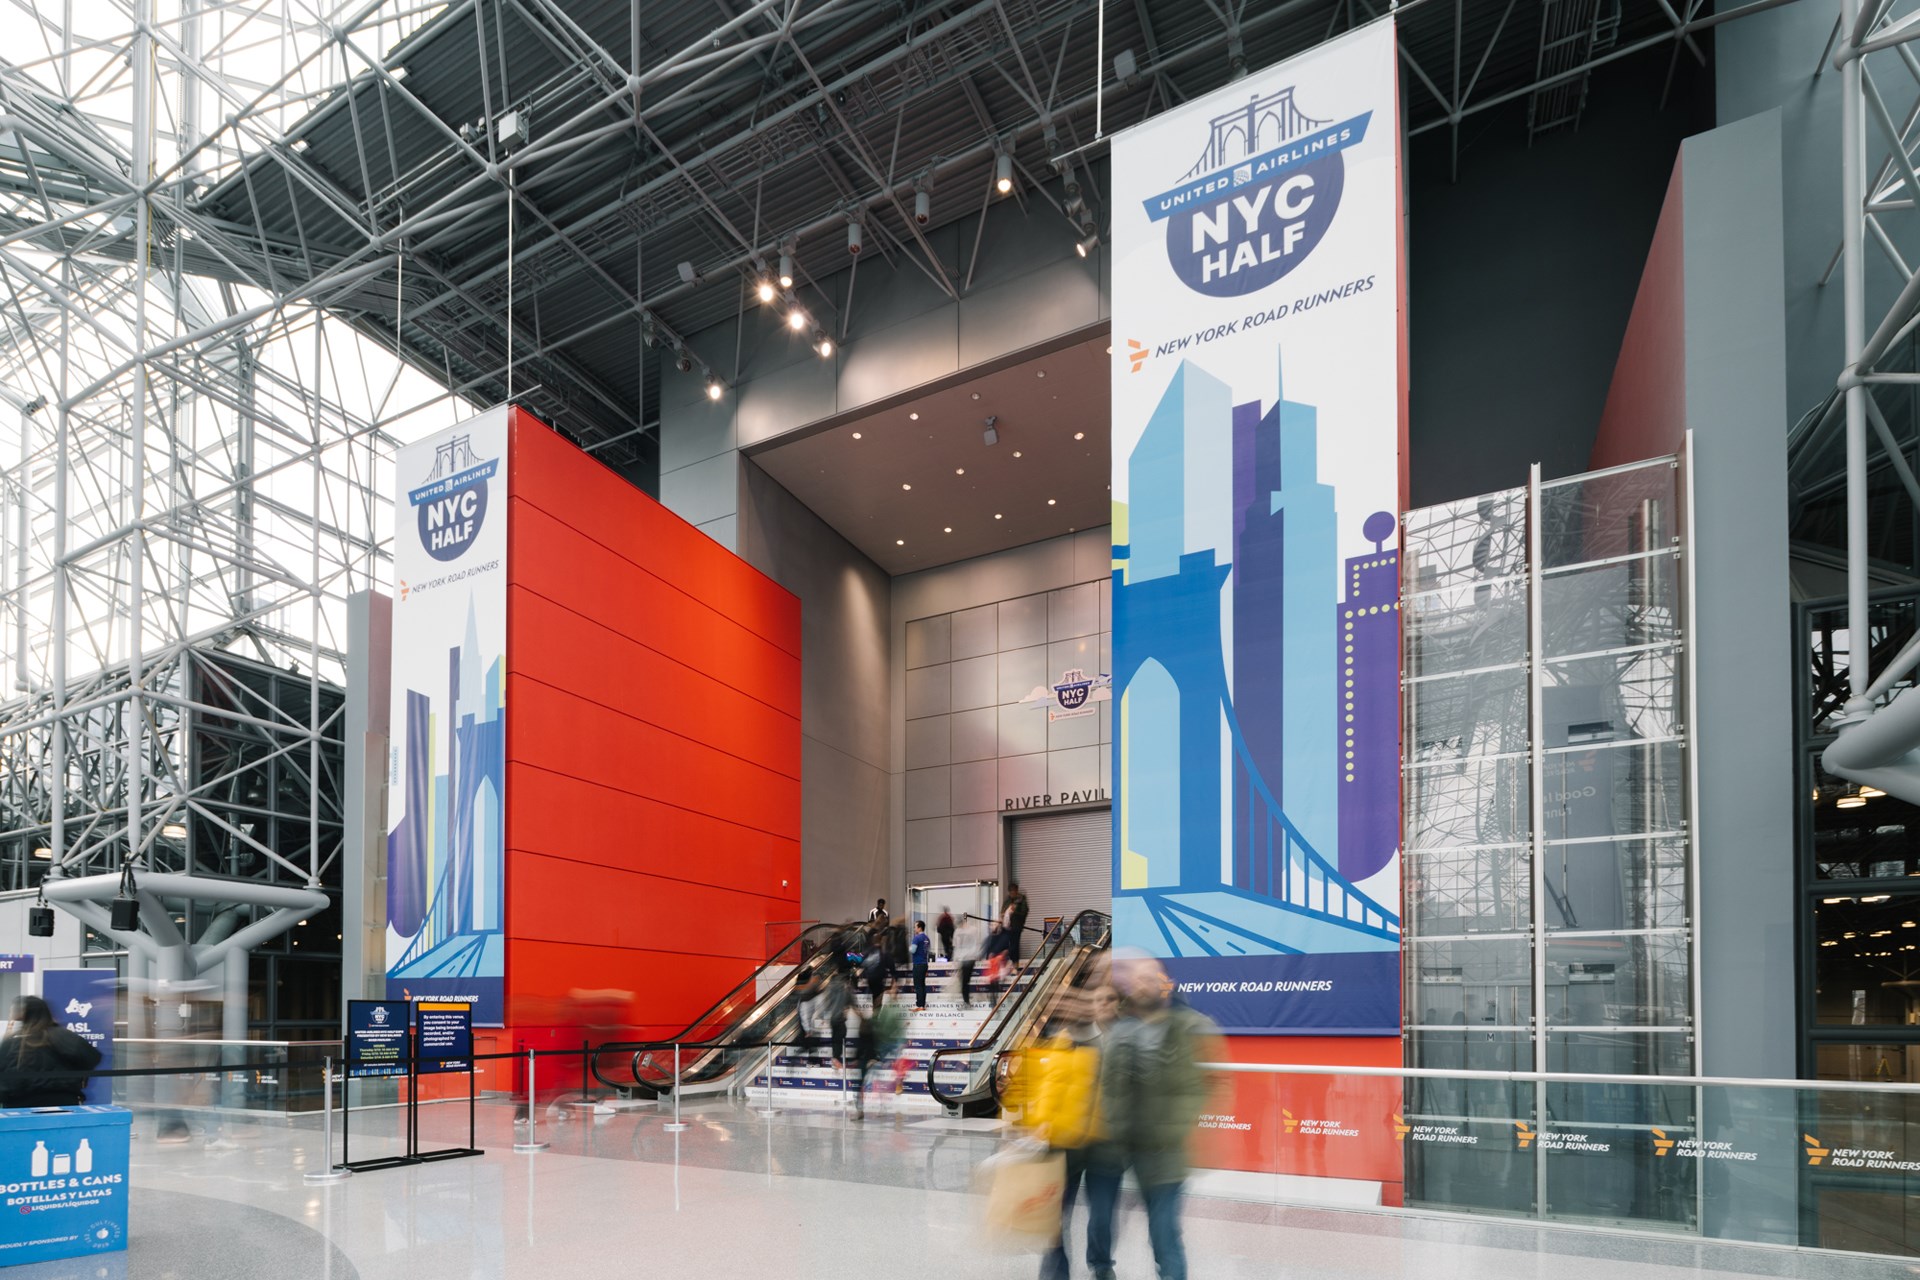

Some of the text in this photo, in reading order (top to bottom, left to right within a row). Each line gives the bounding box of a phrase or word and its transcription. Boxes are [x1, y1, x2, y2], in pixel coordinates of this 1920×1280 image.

[1160, 128, 1351, 211] UNITED AIRLINES
[1192, 174, 1315, 254] NYC
[1202, 220, 1306, 284] HALF
[1155, 275, 1376, 358] NEW YORK ROAD RUNNERS
[415, 466, 492, 501] UNITED AIRLINES
[427, 490, 477, 531] NYC
[431, 520, 474, 551] HALF
[411, 560, 499, 594] NEW YORK ROAD RUNNERS
[1062, 688, 1084, 699] NYC
[1064, 697, 1083, 706] HALF
[1005, 788, 1109, 811] RIVER PAVIL
[1177, 981, 1332, 993] NEW YORK ROAD RUNNERS
[66, 1022, 91, 1033] ASL
[1217, 1123, 1251, 1131] RUNNERS
[1300, 1119, 1341, 1128] NEW YORK
[1322, 1128, 1359, 1137] RUNNERS
[1434, 1126, 1458, 1135] YORK
[1412, 1133, 1478, 1144] ROAD RUNNERS
[1538, 1132, 1588, 1143] NEW YORK
[1537, 1141, 1610, 1152] ROAD RUNNERS
[1676, 1140, 1732, 1151] NEW YORK
[1676, 1148, 1757, 1161] ROAD RUNNERS
[1832, 1149, 1895, 1159] NEW YORK
[1831, 1157, 1920, 1171] ROAD RUNNERS
[0, 1174, 122, 1194] BOTTLES & CANS
[7, 1188, 112, 1206] BOTELLAS Y LATAS
[31, 1199, 100, 1212] LIQUIDS/LÍQUIDOS
[28, 1237, 69, 1246] SPONSORED
